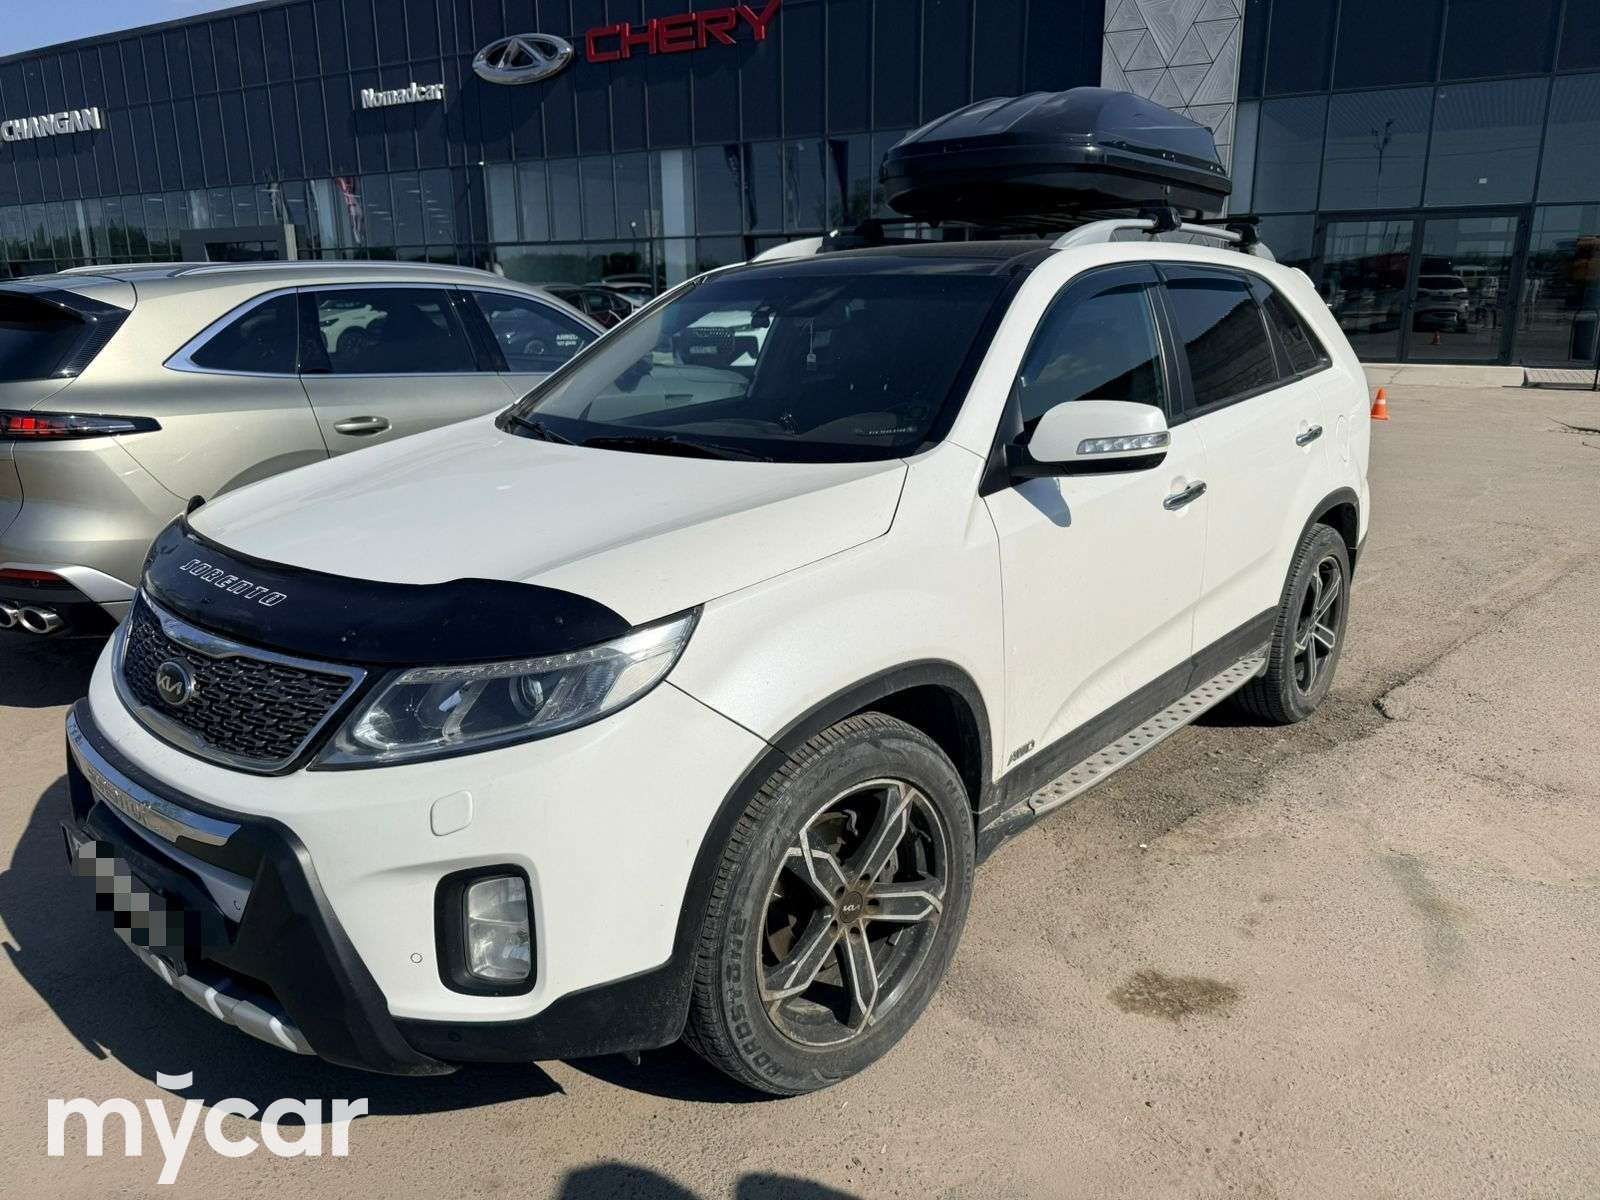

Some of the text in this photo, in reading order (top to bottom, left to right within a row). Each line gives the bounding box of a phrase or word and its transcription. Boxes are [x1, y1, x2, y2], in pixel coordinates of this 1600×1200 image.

[585, 0, 781, 63] CHERY
[361, 82, 444, 109] Nomadcar
[1, 106, 101, 142] CHANGAN
[179, 558, 288, 607] SORENTO
